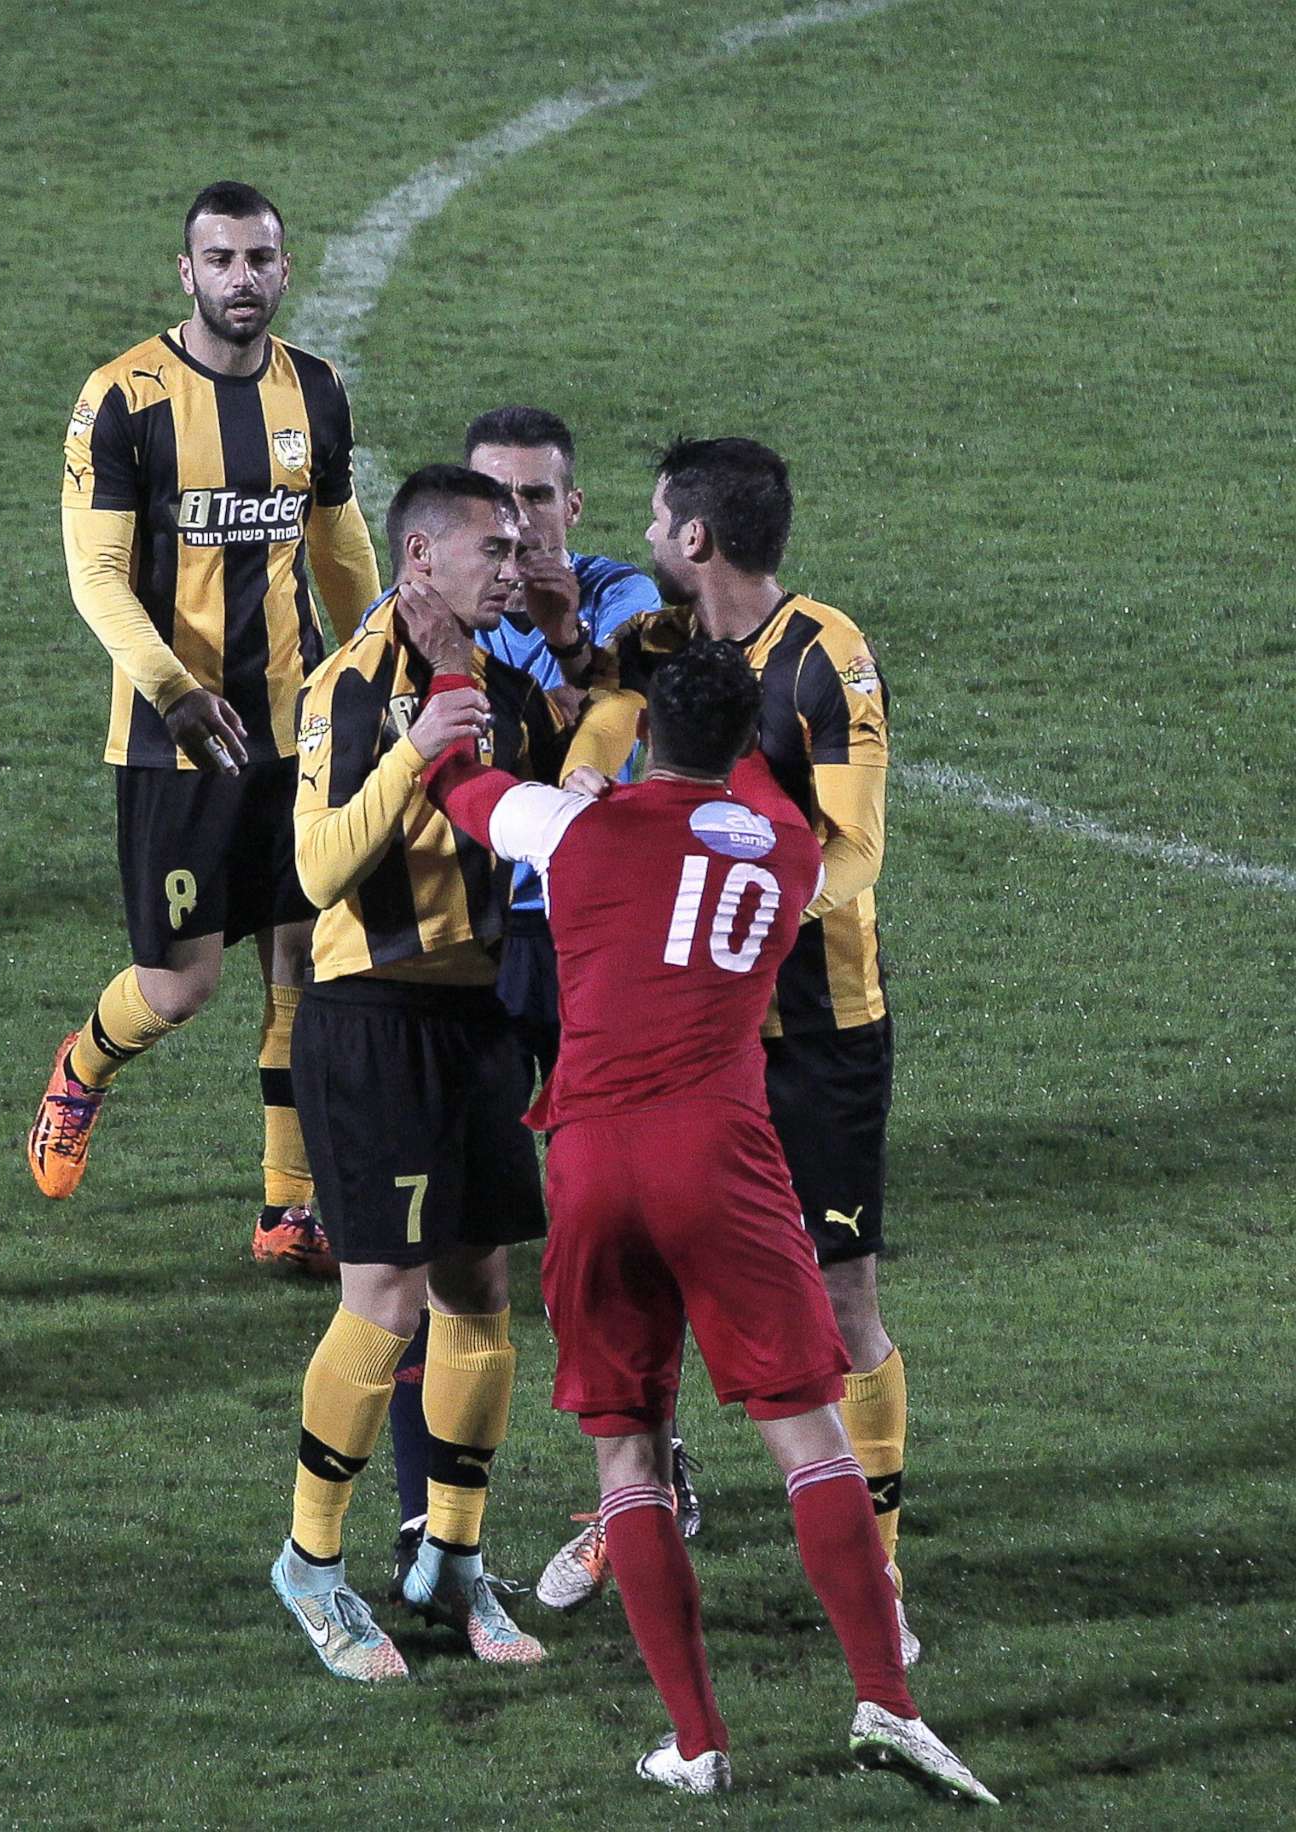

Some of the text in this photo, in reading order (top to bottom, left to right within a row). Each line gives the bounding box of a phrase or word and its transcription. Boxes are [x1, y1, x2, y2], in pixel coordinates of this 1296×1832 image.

[164, 869, 197, 930] 8
[664, 855, 781, 974] 10
[394, 1174, 429, 1244] 7
